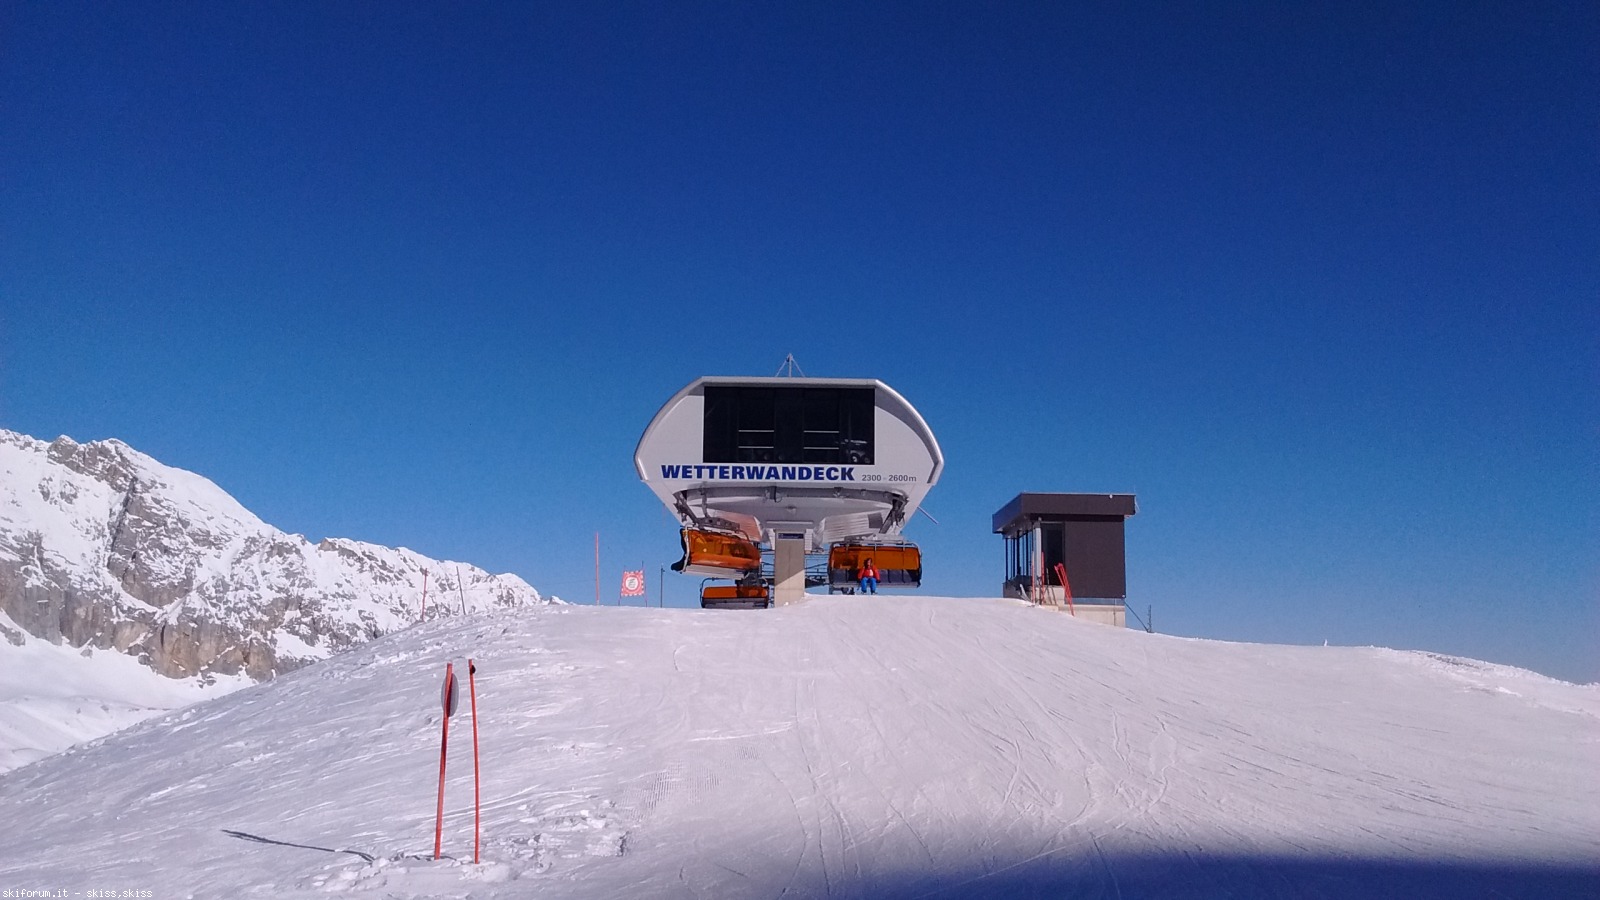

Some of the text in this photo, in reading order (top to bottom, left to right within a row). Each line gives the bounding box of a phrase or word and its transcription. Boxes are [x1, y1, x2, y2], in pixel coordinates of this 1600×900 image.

[661, 465, 855, 481] WETTERWANDECK
[861, 474, 882, 482] 2300
[888, 474, 917, 482] 2600m
